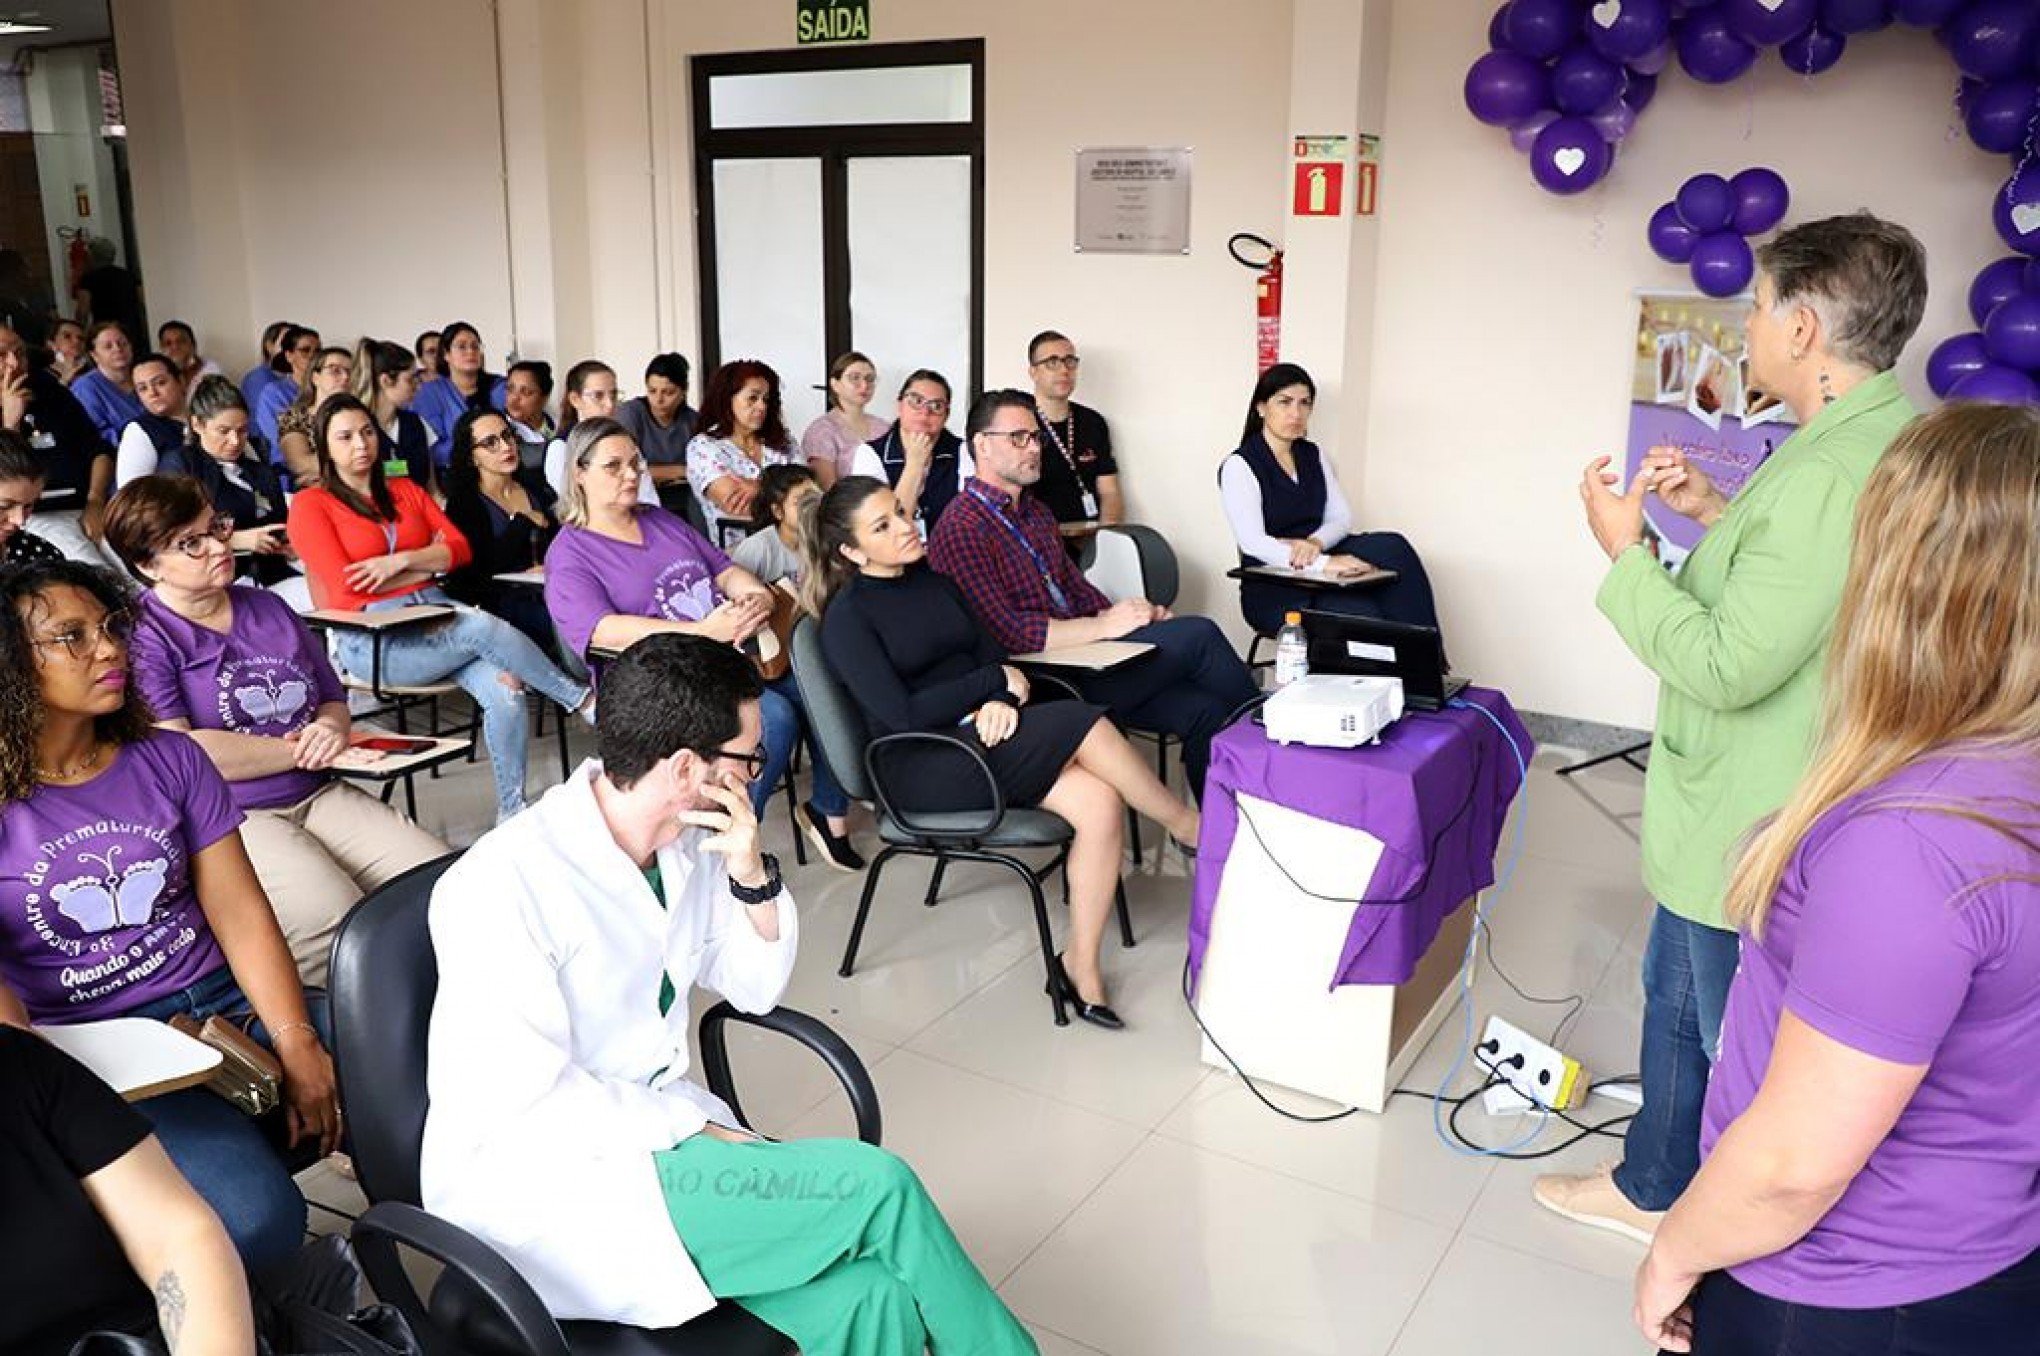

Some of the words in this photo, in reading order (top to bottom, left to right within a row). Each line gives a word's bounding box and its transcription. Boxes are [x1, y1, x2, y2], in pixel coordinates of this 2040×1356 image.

[799, 0, 868, 40] SAÍDA
[23, 861, 50, 887] da
[40, 819, 180, 870] Prematuridad
[61, 955, 129, 988] Quando
[129, 946, 143, 959] o
[126, 951, 167, 983] mais
[713, 1166, 861, 1202] CAMILO
